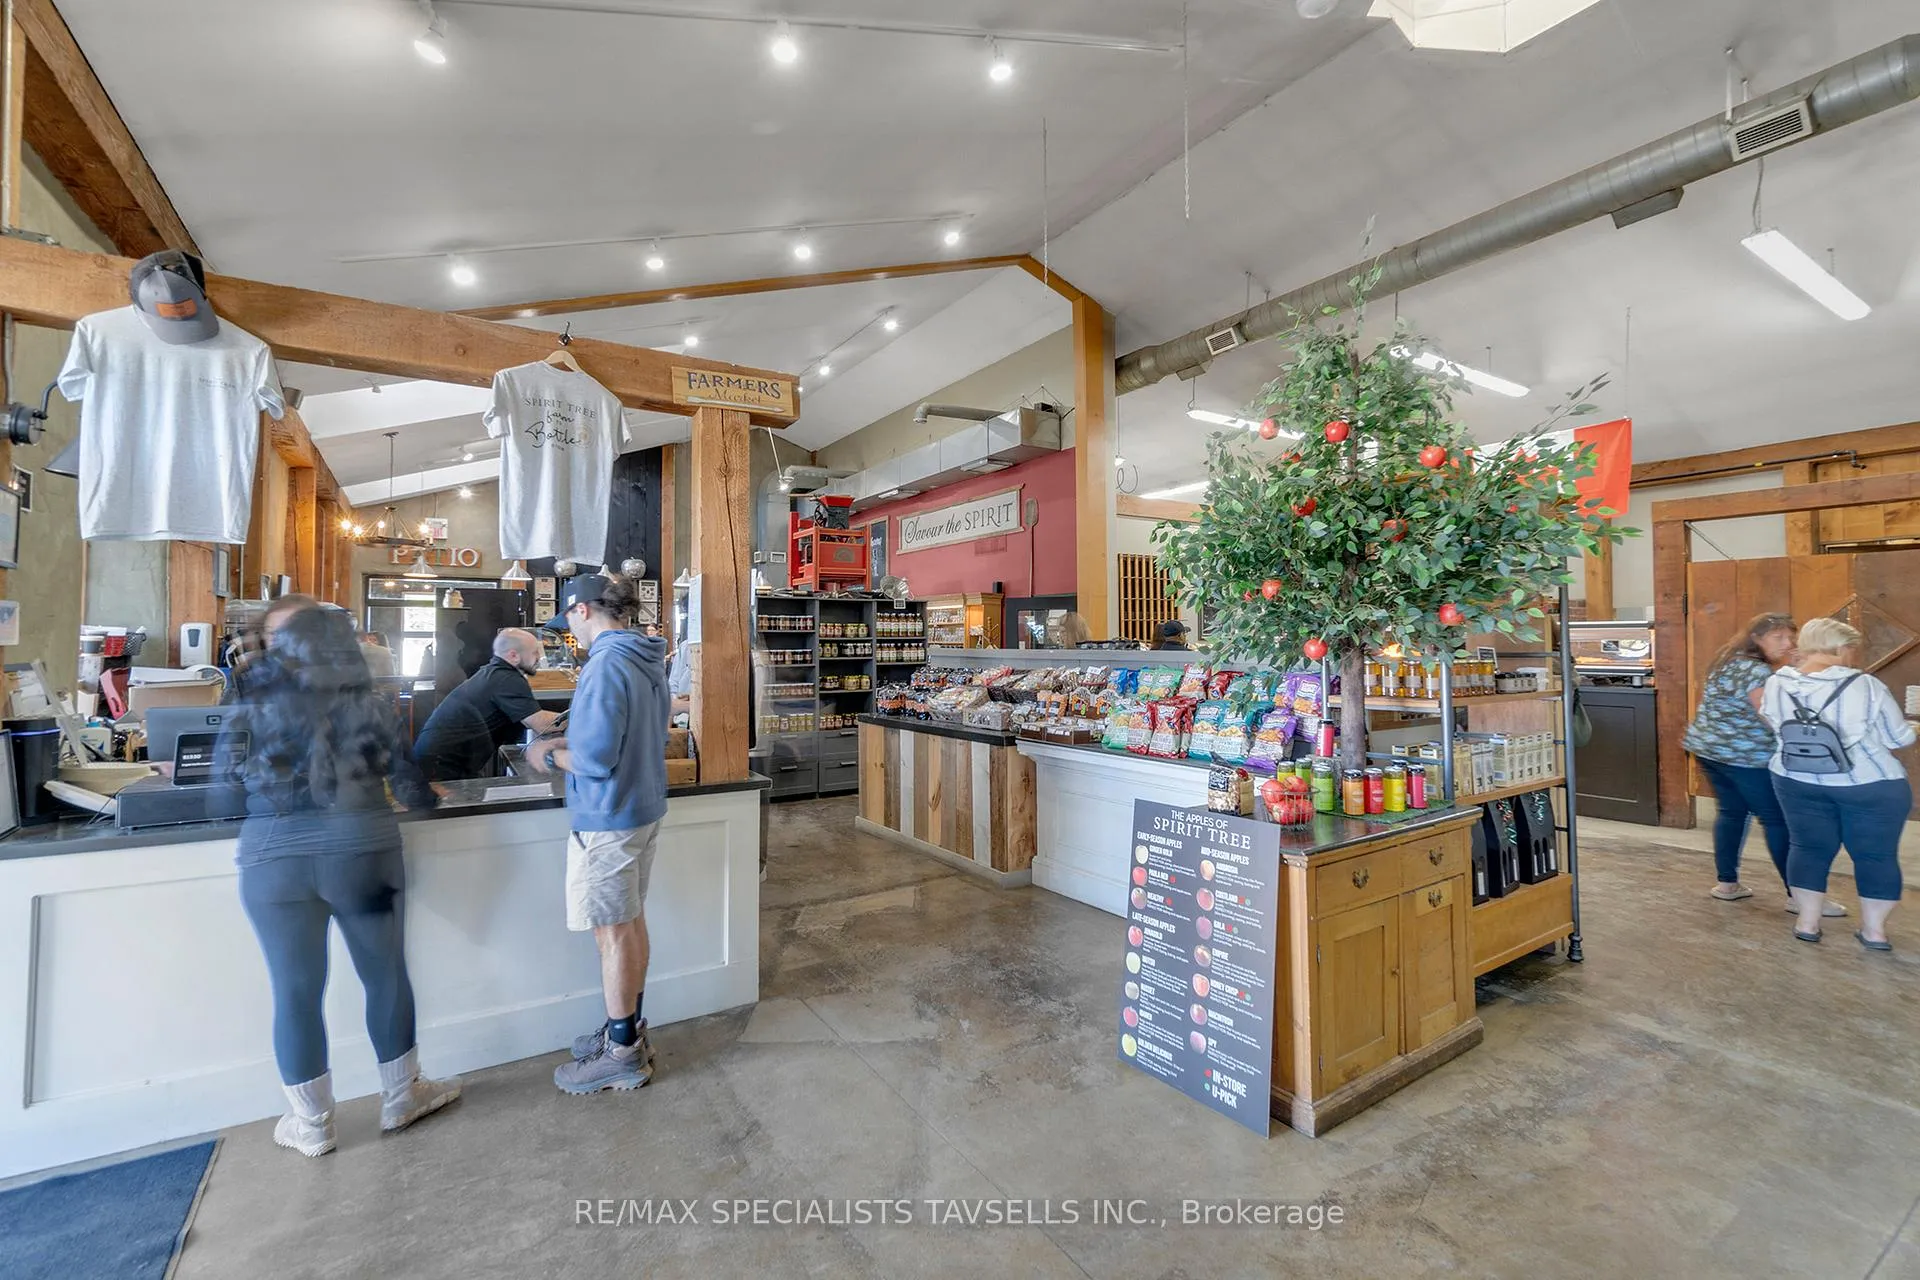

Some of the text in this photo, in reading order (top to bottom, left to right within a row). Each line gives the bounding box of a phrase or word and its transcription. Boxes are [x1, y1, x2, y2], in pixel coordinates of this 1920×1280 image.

[687, 371, 781, 399] FARMERS
[524, 398, 597, 418] SPIRIT TREE
[524, 421, 581, 448] Bottle
[905, 502, 1014, 544] Savour the SPIRIT
[391, 545, 478, 567] PTIO
[1171, 810, 1228, 829] THE APPLES OF
[1153, 817, 1251, 850] SPIRIT TREE
[1230, 853, 1250, 865] APPLES
[1212, 1069, 1247, 1098] IN-STORE
[1211, 1085, 1237, 1109] U-PICK
